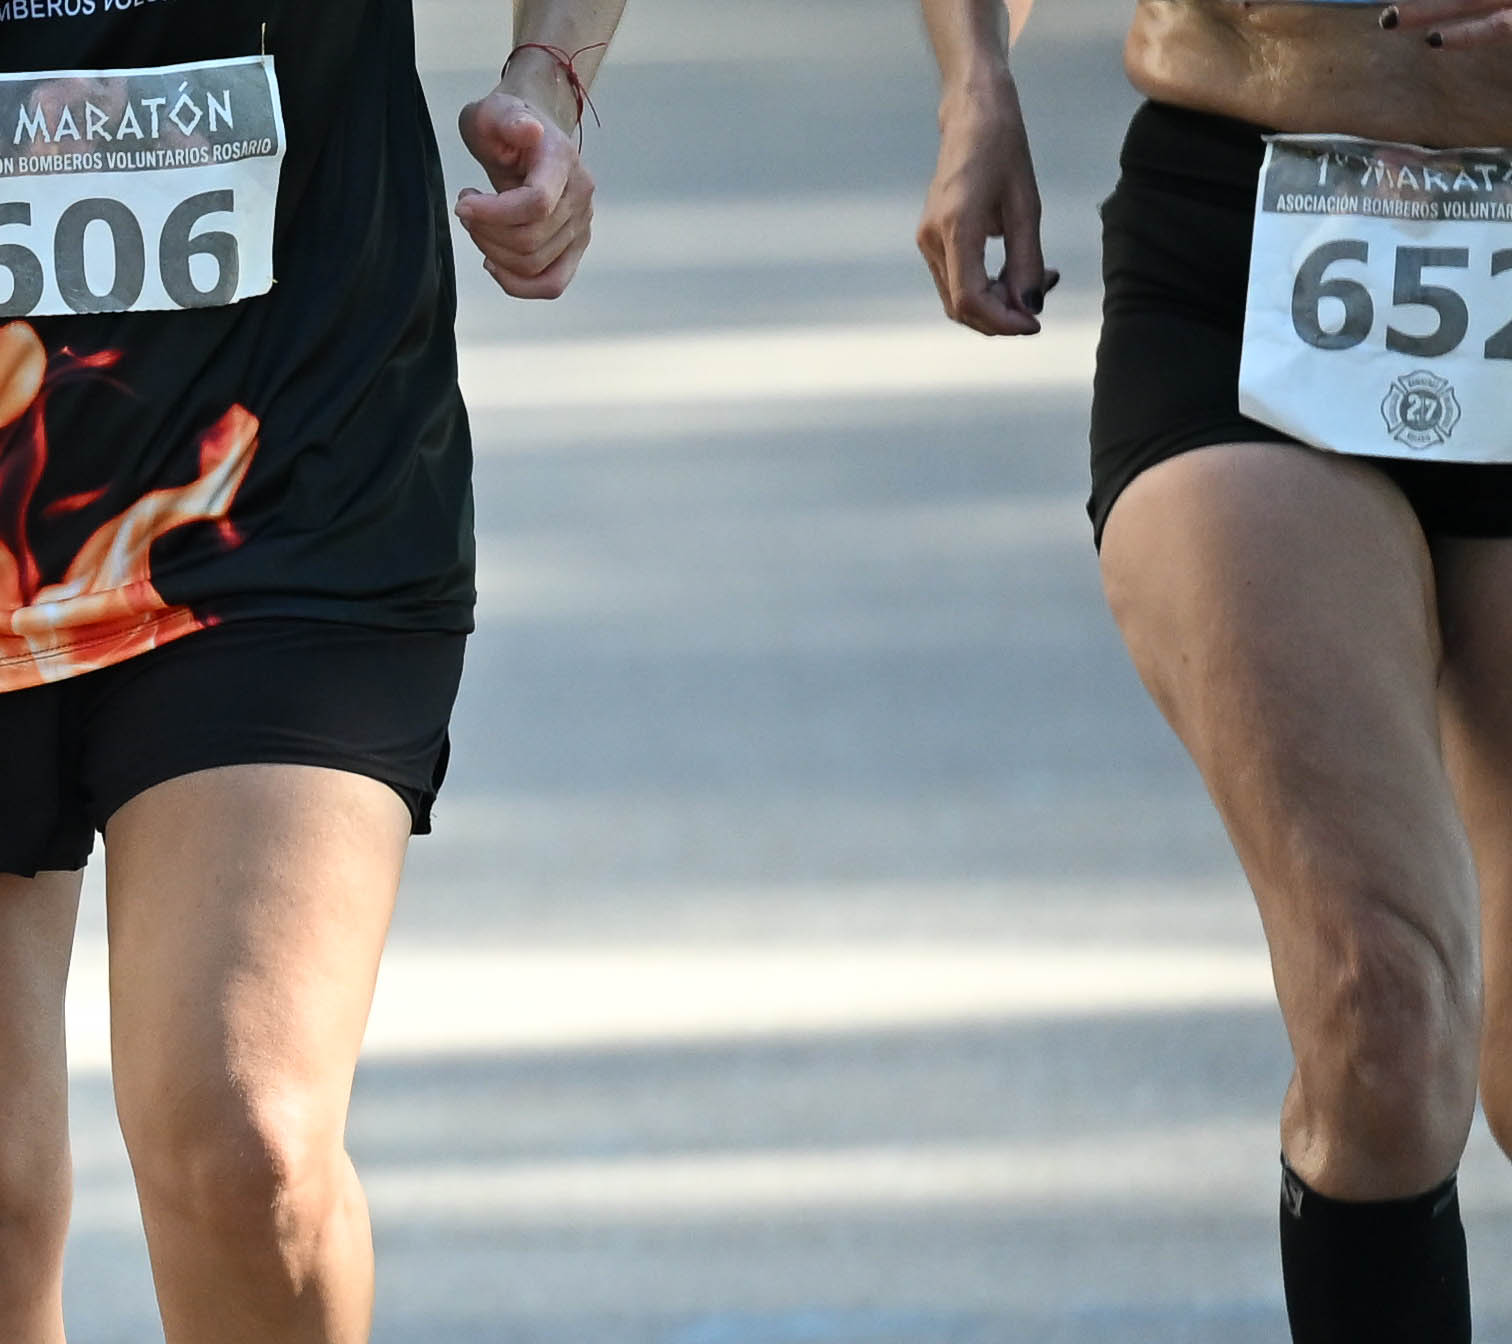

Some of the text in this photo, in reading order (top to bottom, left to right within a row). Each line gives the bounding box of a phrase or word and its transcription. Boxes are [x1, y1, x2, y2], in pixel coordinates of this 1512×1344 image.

[14, 80, 234, 145] MARATÓN
[18, 152, 102, 173] BOMBEROS
[106, 147, 209, 169] VOLUNTARIOS
[213, 138, 272, 161] ROSARIO
[1276, 191, 1359, 213] ASOCIACIÓN
[1363, 197, 1439, 219] BOMBEROS
